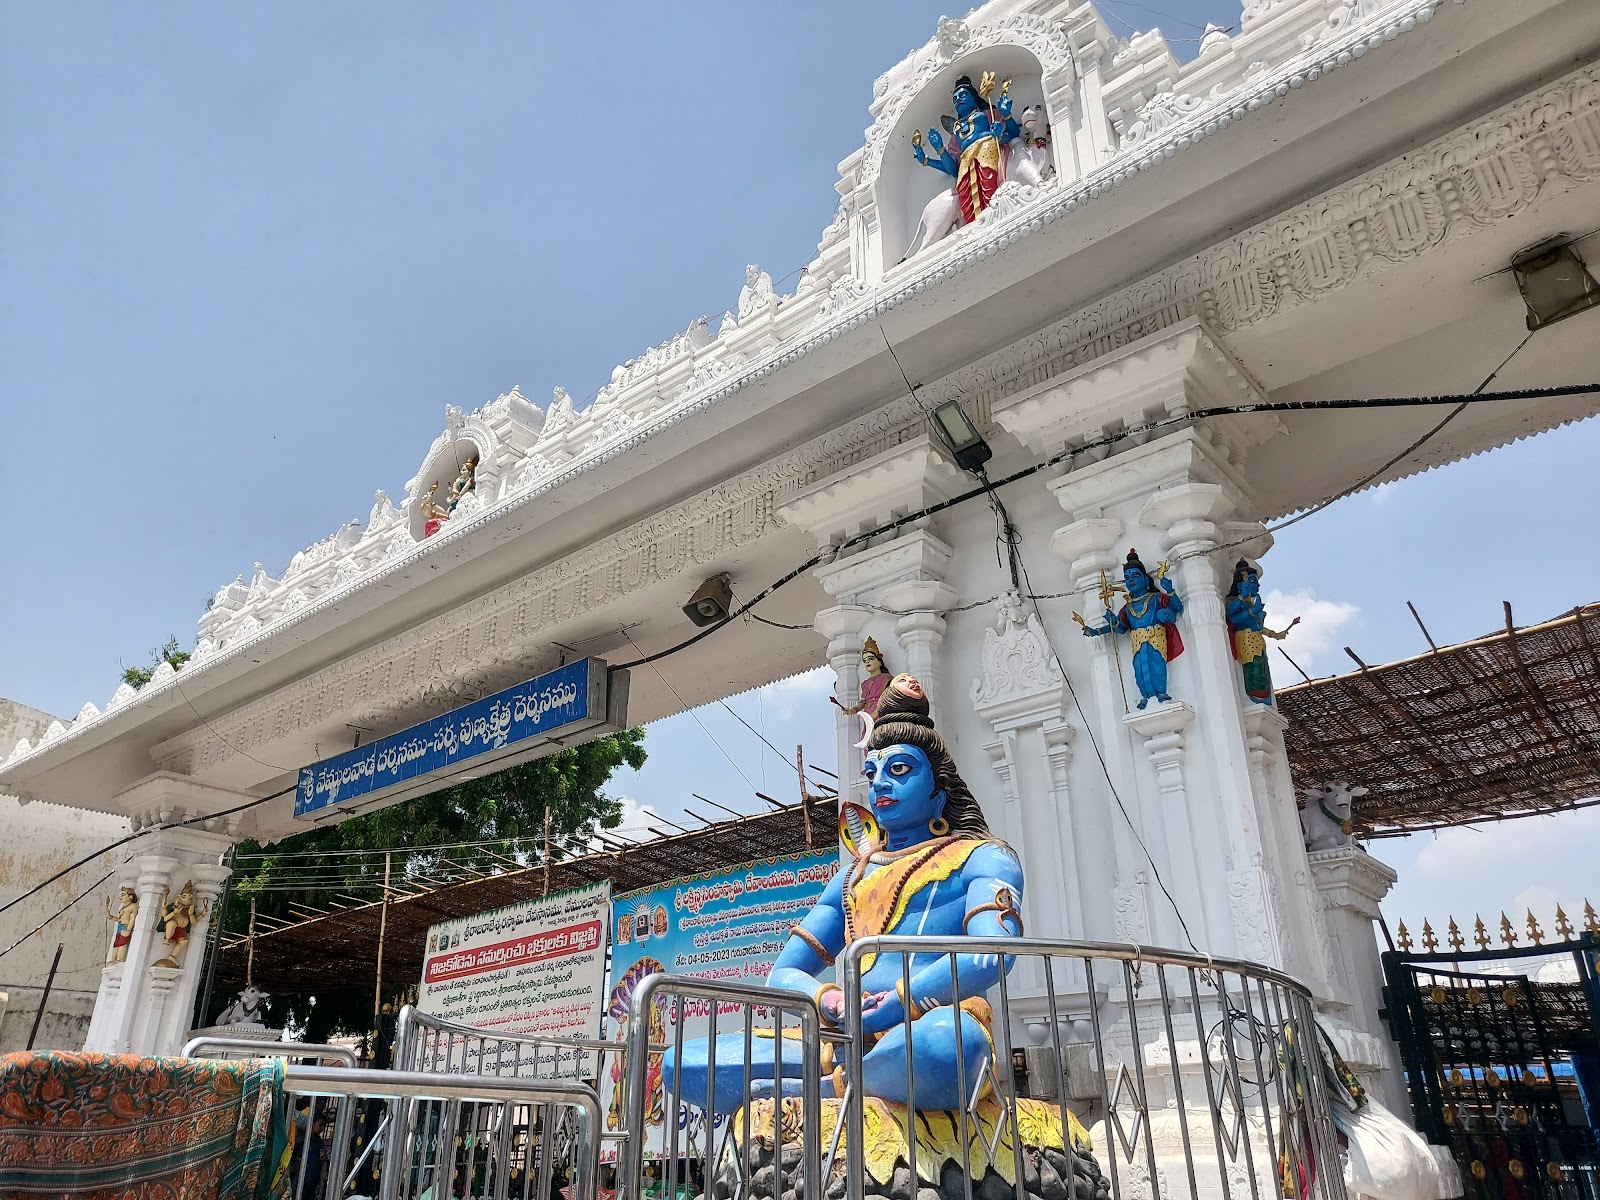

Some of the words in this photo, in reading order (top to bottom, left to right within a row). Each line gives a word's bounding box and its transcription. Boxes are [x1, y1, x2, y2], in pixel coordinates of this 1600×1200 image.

[316, 753, 376, 794] వేములవాడ
[460, 699, 512, 745] పుణ్యక్షేత్ర
[513, 682, 577, 724] దర్శనము
[477, 942, 525, 965] సమర్పించు
[527, 933, 568, 957] భక్తులకు
[570, 926, 597, 950] విజ్ఞప్తి
[688, 948, 730, 965] 04-05-2023
